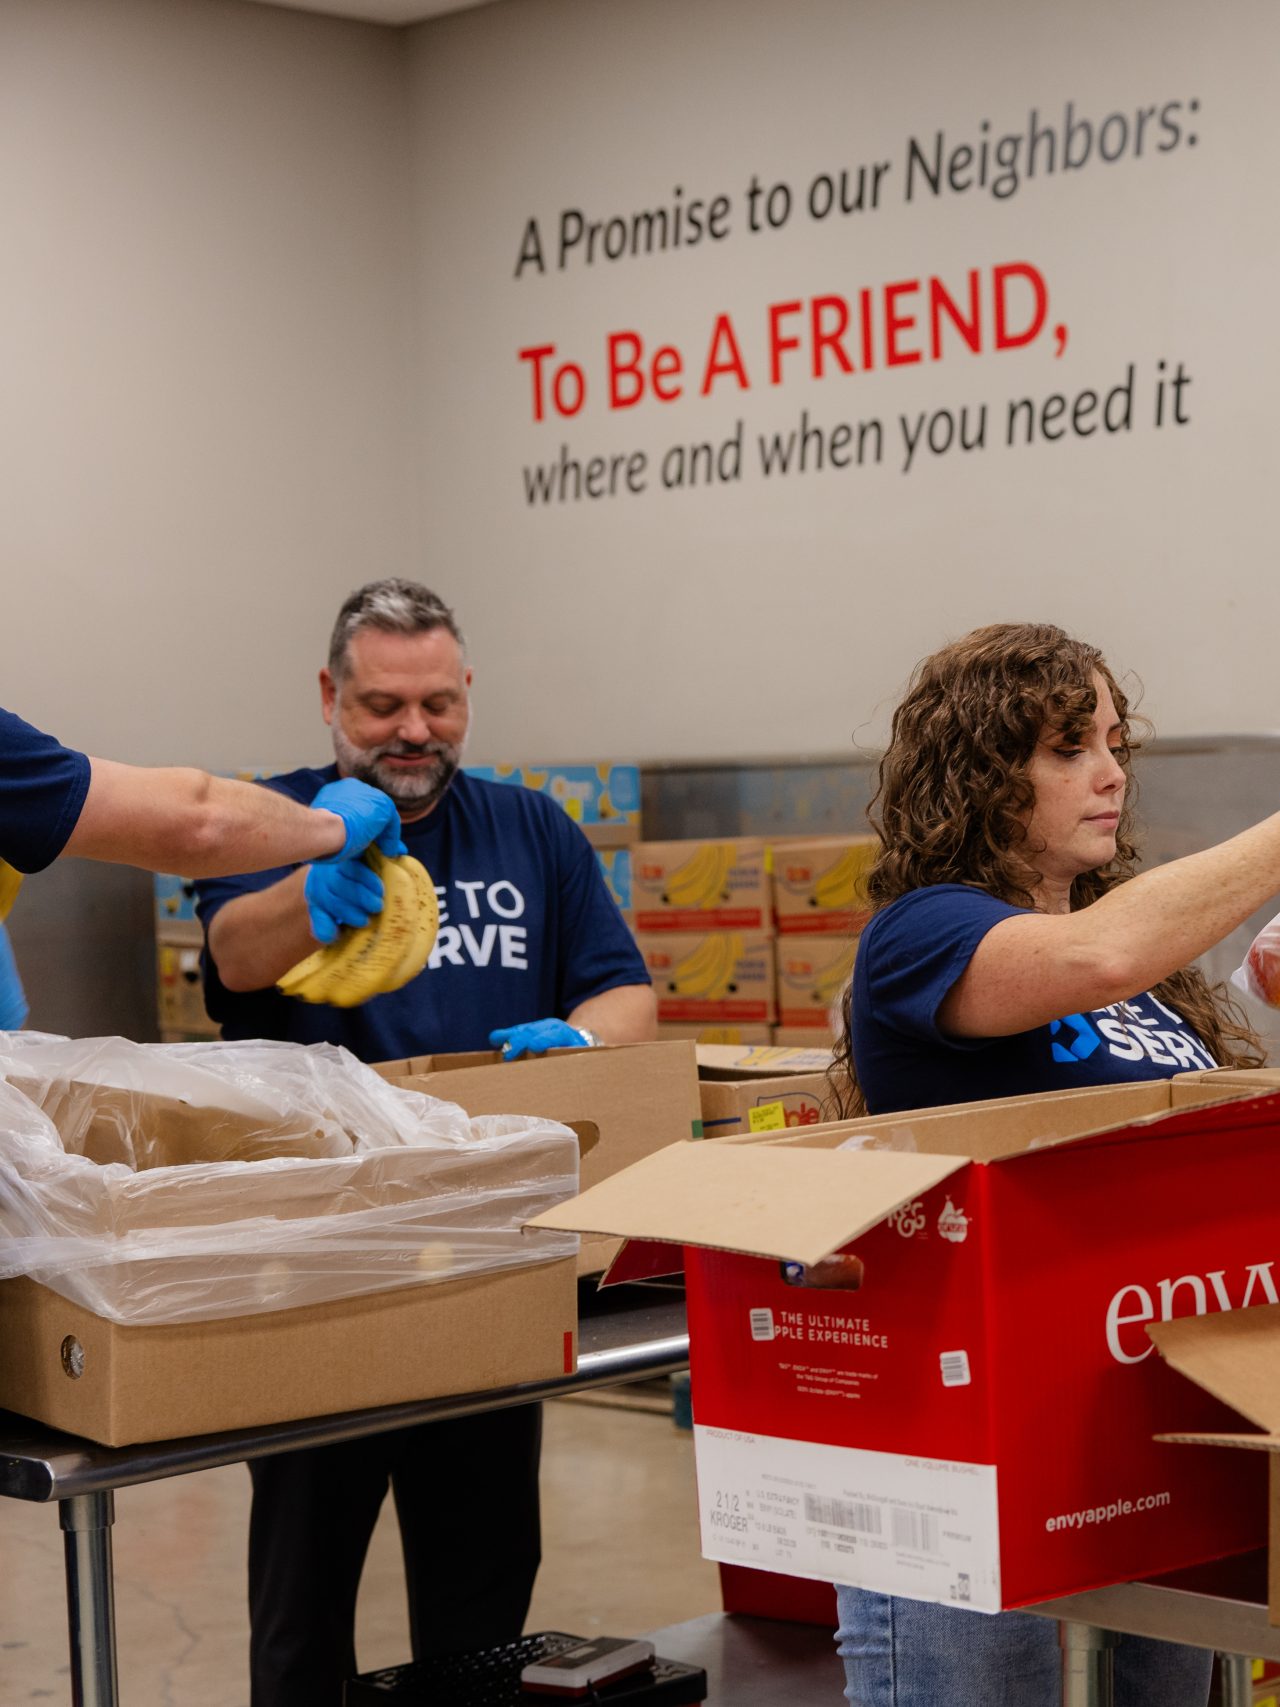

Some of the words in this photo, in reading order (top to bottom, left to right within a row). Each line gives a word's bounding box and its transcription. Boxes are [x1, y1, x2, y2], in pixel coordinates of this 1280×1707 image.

[514, 217, 546, 278] A
[558, 187, 731, 270] Promise
[746, 177, 793, 234] to
[807, 161, 891, 221] our
[904, 99, 1202, 203] Neighbors:
[517, 343, 587, 423] To
[606, 329, 684, 412] Be
[699, 312, 752, 398] A
[765, 260, 1069, 387] FRIEND,
[523, 444, 648, 506] where
[661, 420, 744, 489] and
[758, 410, 884, 477] when
[899, 403, 988, 474] you
[1006, 362, 1136, 447] need
[1154, 359, 1192, 429] it
[454, 880, 525, 919] TO
[424, 923, 529, 970] RVE
[774, 1325, 804, 1340] PPLE
[808, 1329, 889, 1349] EXPERIENCE
[781, 1312, 803, 1326] THE
[808, 1315, 870, 1332] ULTIMATE
[710, 1510, 749, 1534] KROGER
[1045, 1490, 1171, 1533] envyapple.com
